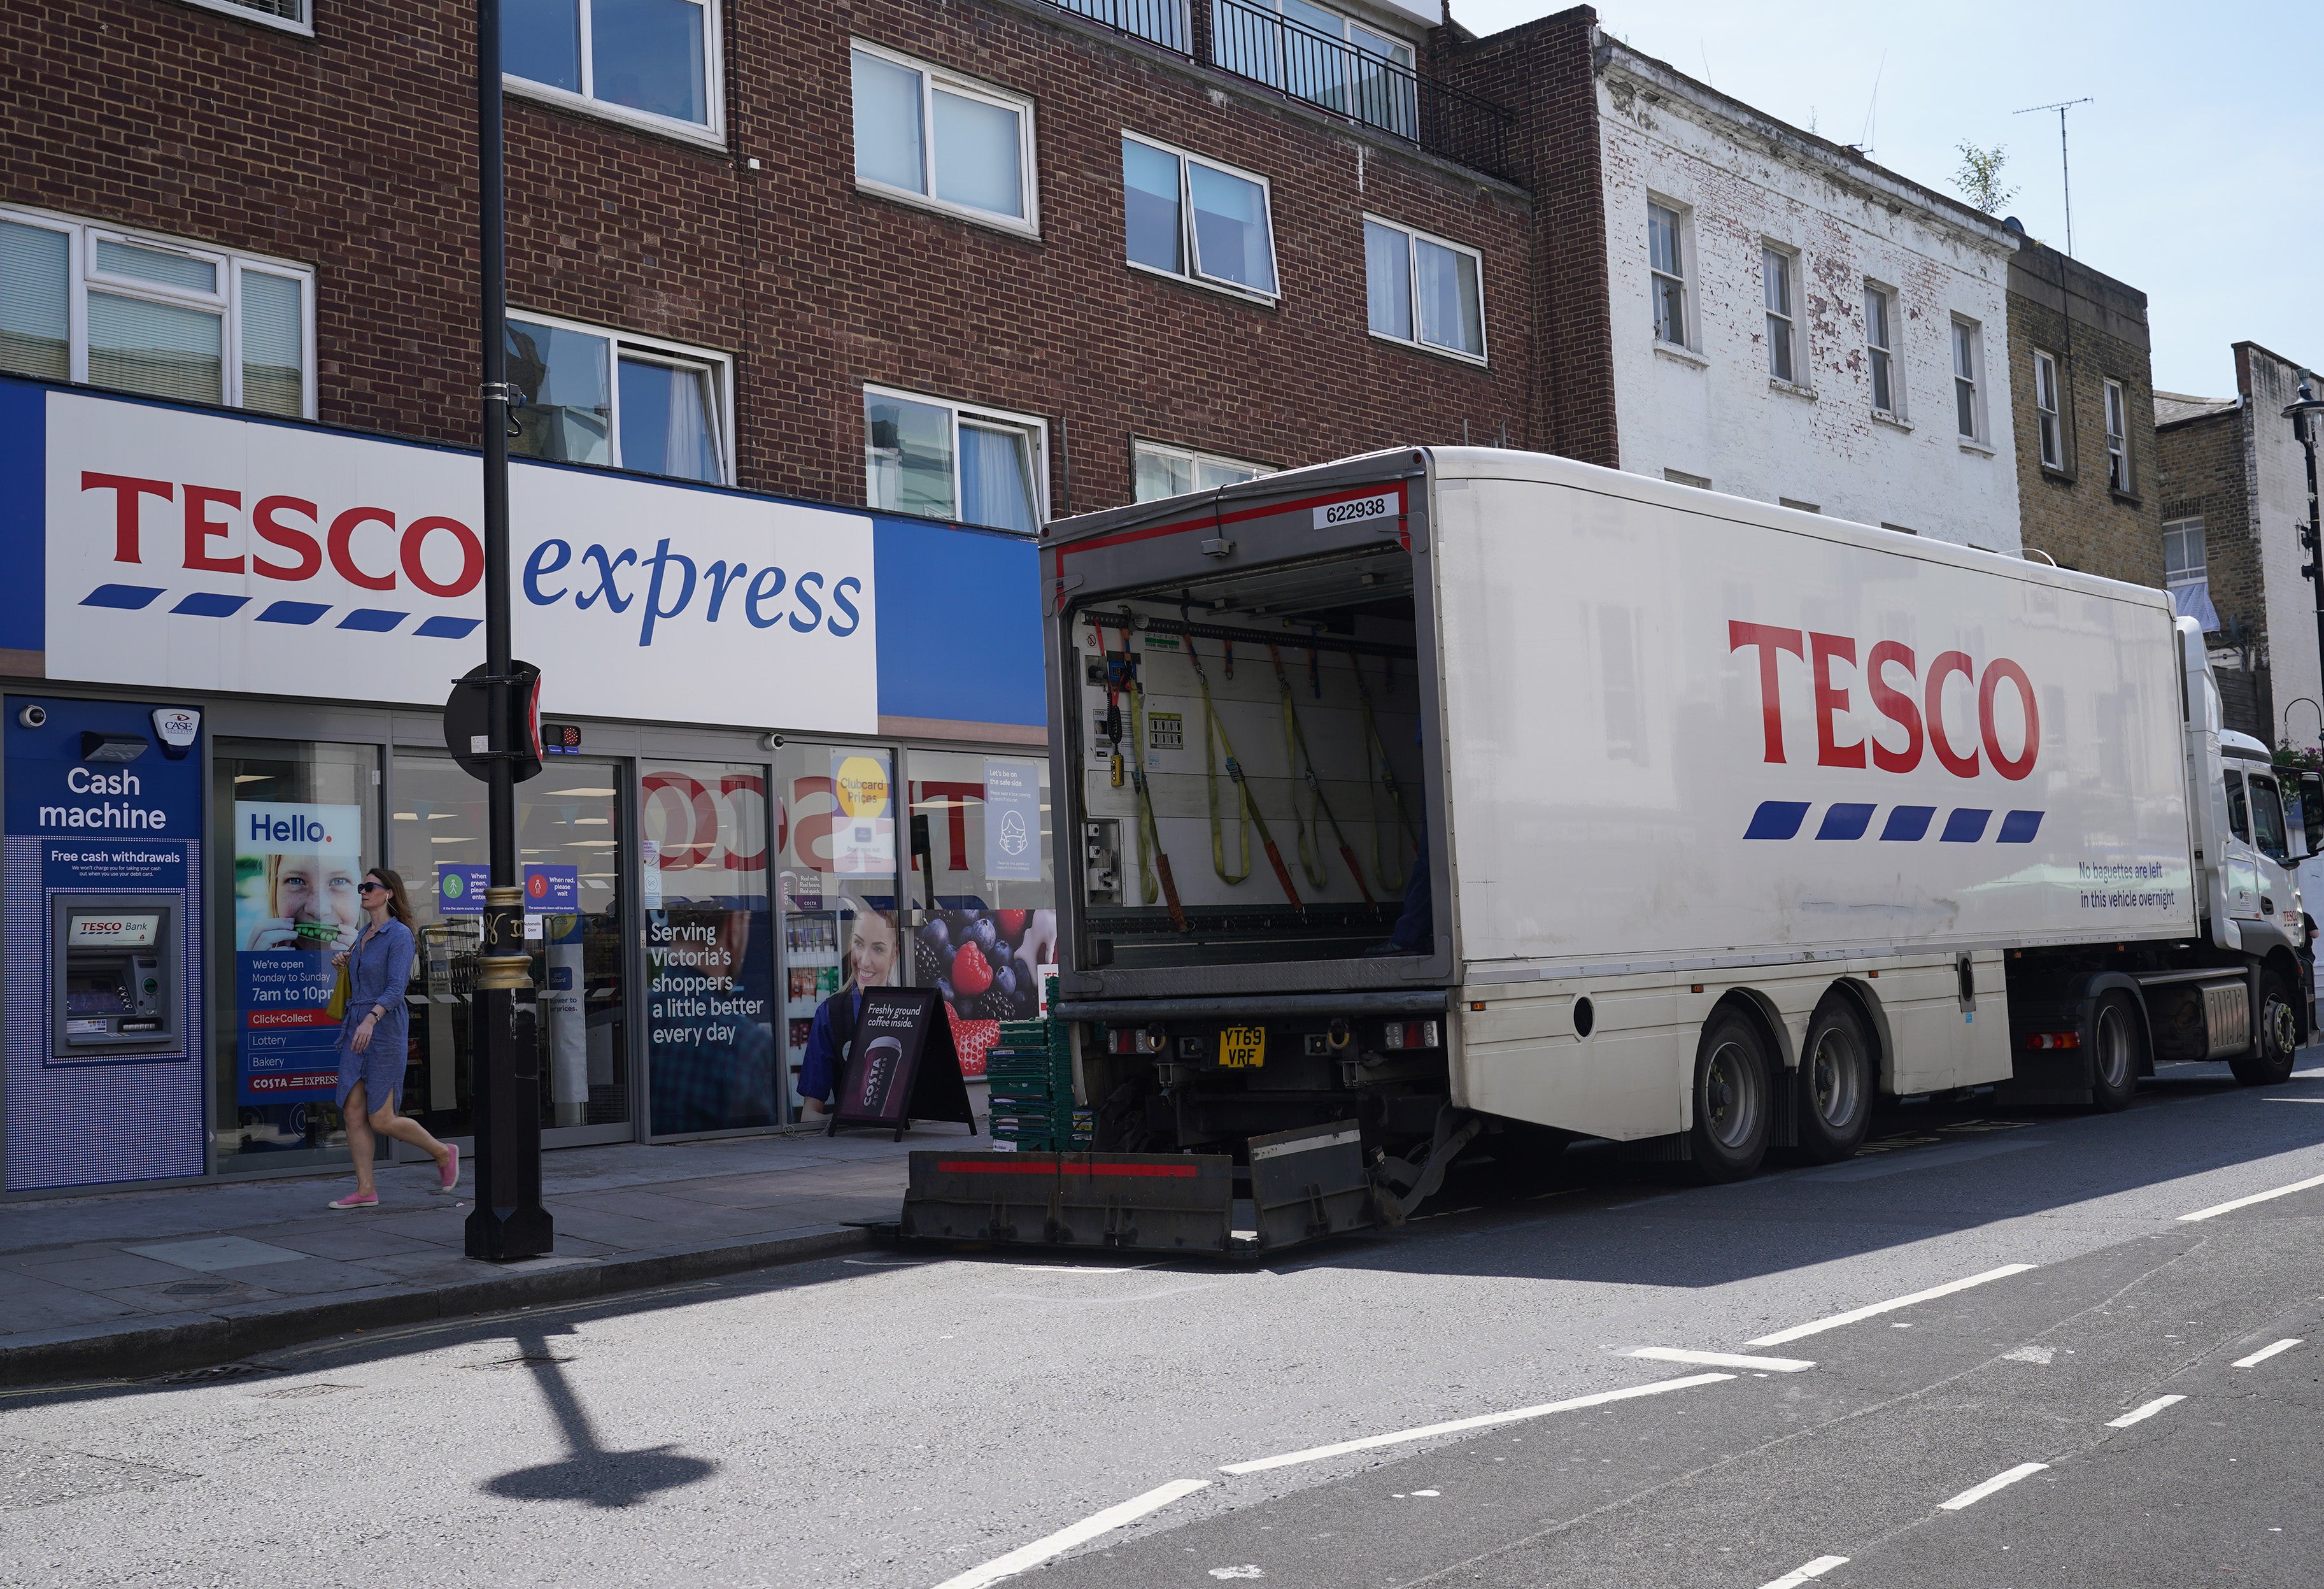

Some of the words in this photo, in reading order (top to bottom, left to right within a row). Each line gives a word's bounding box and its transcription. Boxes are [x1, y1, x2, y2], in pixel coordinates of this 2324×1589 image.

[1326, 498, 1385, 523] 622938
[81, 470, 485, 597] TESCO
[522, 538, 861, 647] express
[1729, 619, 2040, 781] TESCO
[165, 722, 193, 730] CASE
[67, 767, 140, 795] Cash
[840, 777, 884, 790] Clubcard
[847, 792, 877, 803] Prices
[40, 802, 166, 829] machine
[251, 813, 332, 842] Hello.
[52, 850, 78, 862] Free
[81, 852, 109, 862] cash
[111, 852, 181, 863] withdrawals
[2079, 862, 2091, 879] No
[2093, 862, 2133, 883] baguettes
[2135, 866, 2148, 878] are
[2149, 862, 2163, 878] left
[2081, 890, 2089, 908] in
[2091, 890, 2107, 908] this
[2108, 890, 2137, 908] vehicle
[2139, 889, 2175, 910] overnight
[81, 922, 122, 930] TESCO
[125, 922, 148, 930] Bank
[651, 922, 716, 946] Serving
[281, 961, 304, 971] open
[252, 974, 287, 984] Monday
[300, 973, 331, 983] Sunday
[652, 973, 733, 997] shoppers
[252, 988, 281, 1001] 7am
[285, 988, 300, 1001] to
[653, 1003, 663, 1018] a
[667, 997, 706, 1018] little
[711, 997, 763, 1016] better
[867, 1003, 895, 1018] Freshly
[894, 1004, 921, 1019] ground
[252, 1013, 313, 1024] Click+Collect
[867, 1016, 890, 1027] coffee
[890, 1017, 913, 1027] inside.
[252, 1036, 287, 1046] Lottery
[653, 1027, 703, 1047] every
[706, 1022, 736, 1045] day
[1225, 1029, 1262, 1046] YT69
[253, 1057, 285, 1068] Bakery
[253, 1078, 288, 1089] COSTA
[304, 1075, 339, 1085] EXPRESS
[863, 1057, 881, 1106] COSTA
[873, 1057, 887, 1099] EXPRESS
